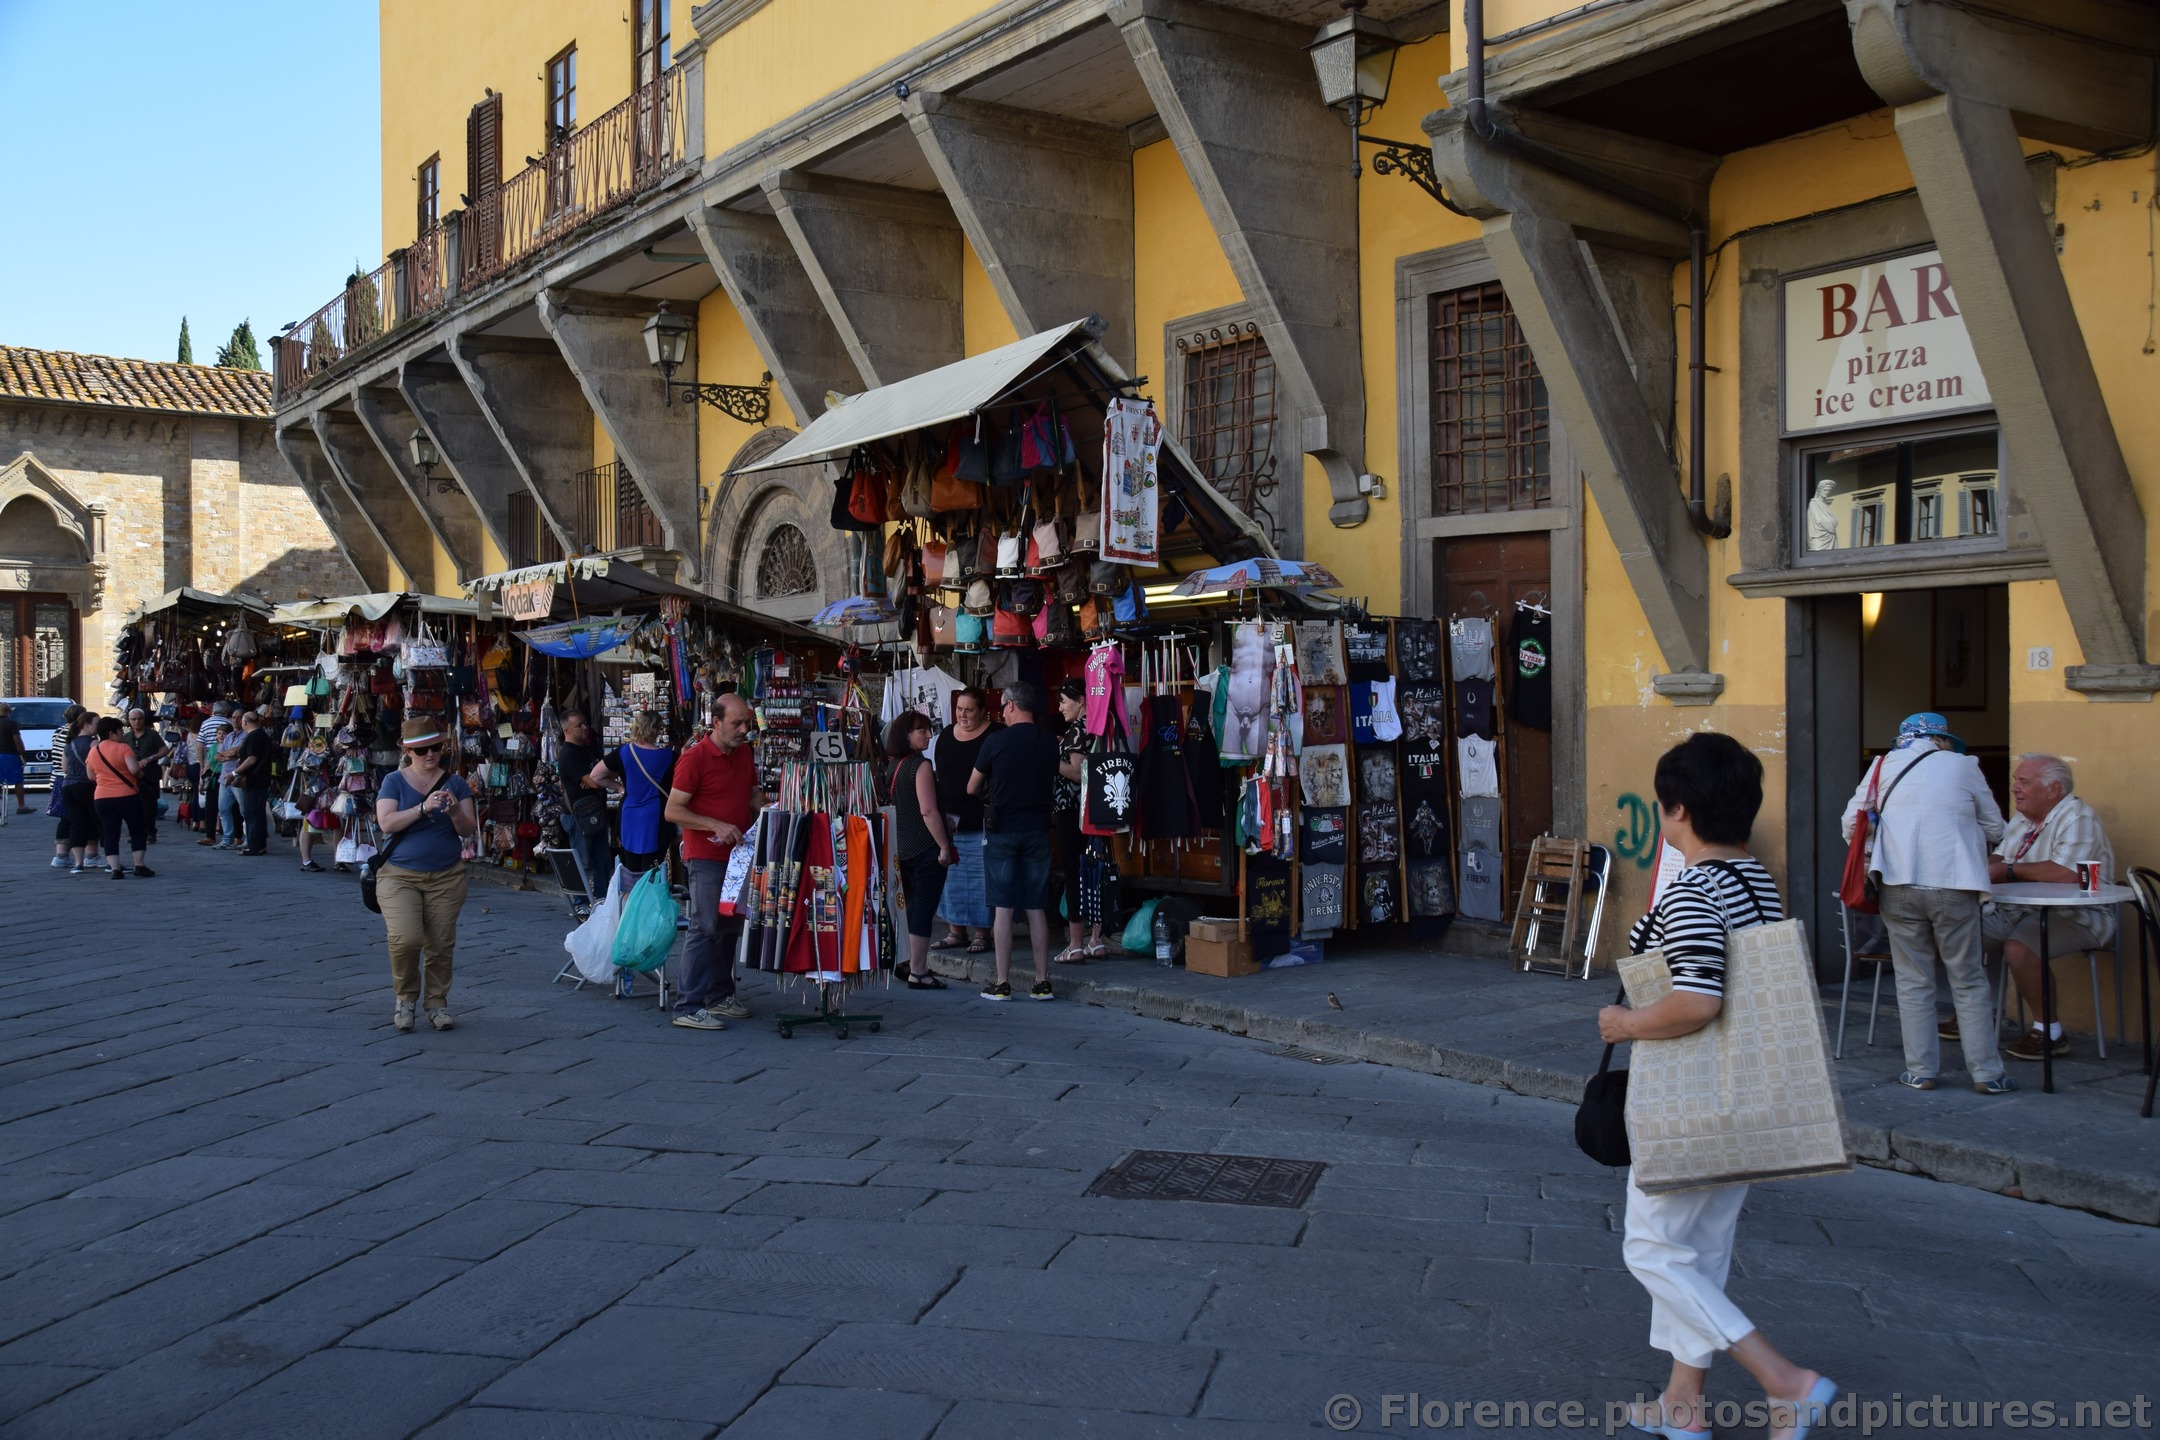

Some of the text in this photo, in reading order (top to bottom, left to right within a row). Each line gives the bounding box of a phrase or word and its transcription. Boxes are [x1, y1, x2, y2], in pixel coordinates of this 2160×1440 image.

[1816, 262, 1960, 342] BAR
[1847, 346, 1927, 384] pizza
[1814, 375, 1962, 417] ice cream
[503, 586, 536, 616] Kodak
[2030, 651, 2050, 668] 18
[1415, 687, 1442, 699] Italia
[1355, 710, 1394, 728] ITALIA
[814, 735, 843, 758] €5
[1408, 752, 1441, 764] ITALIA
[1310, 903, 1342, 917] FIRENZE
